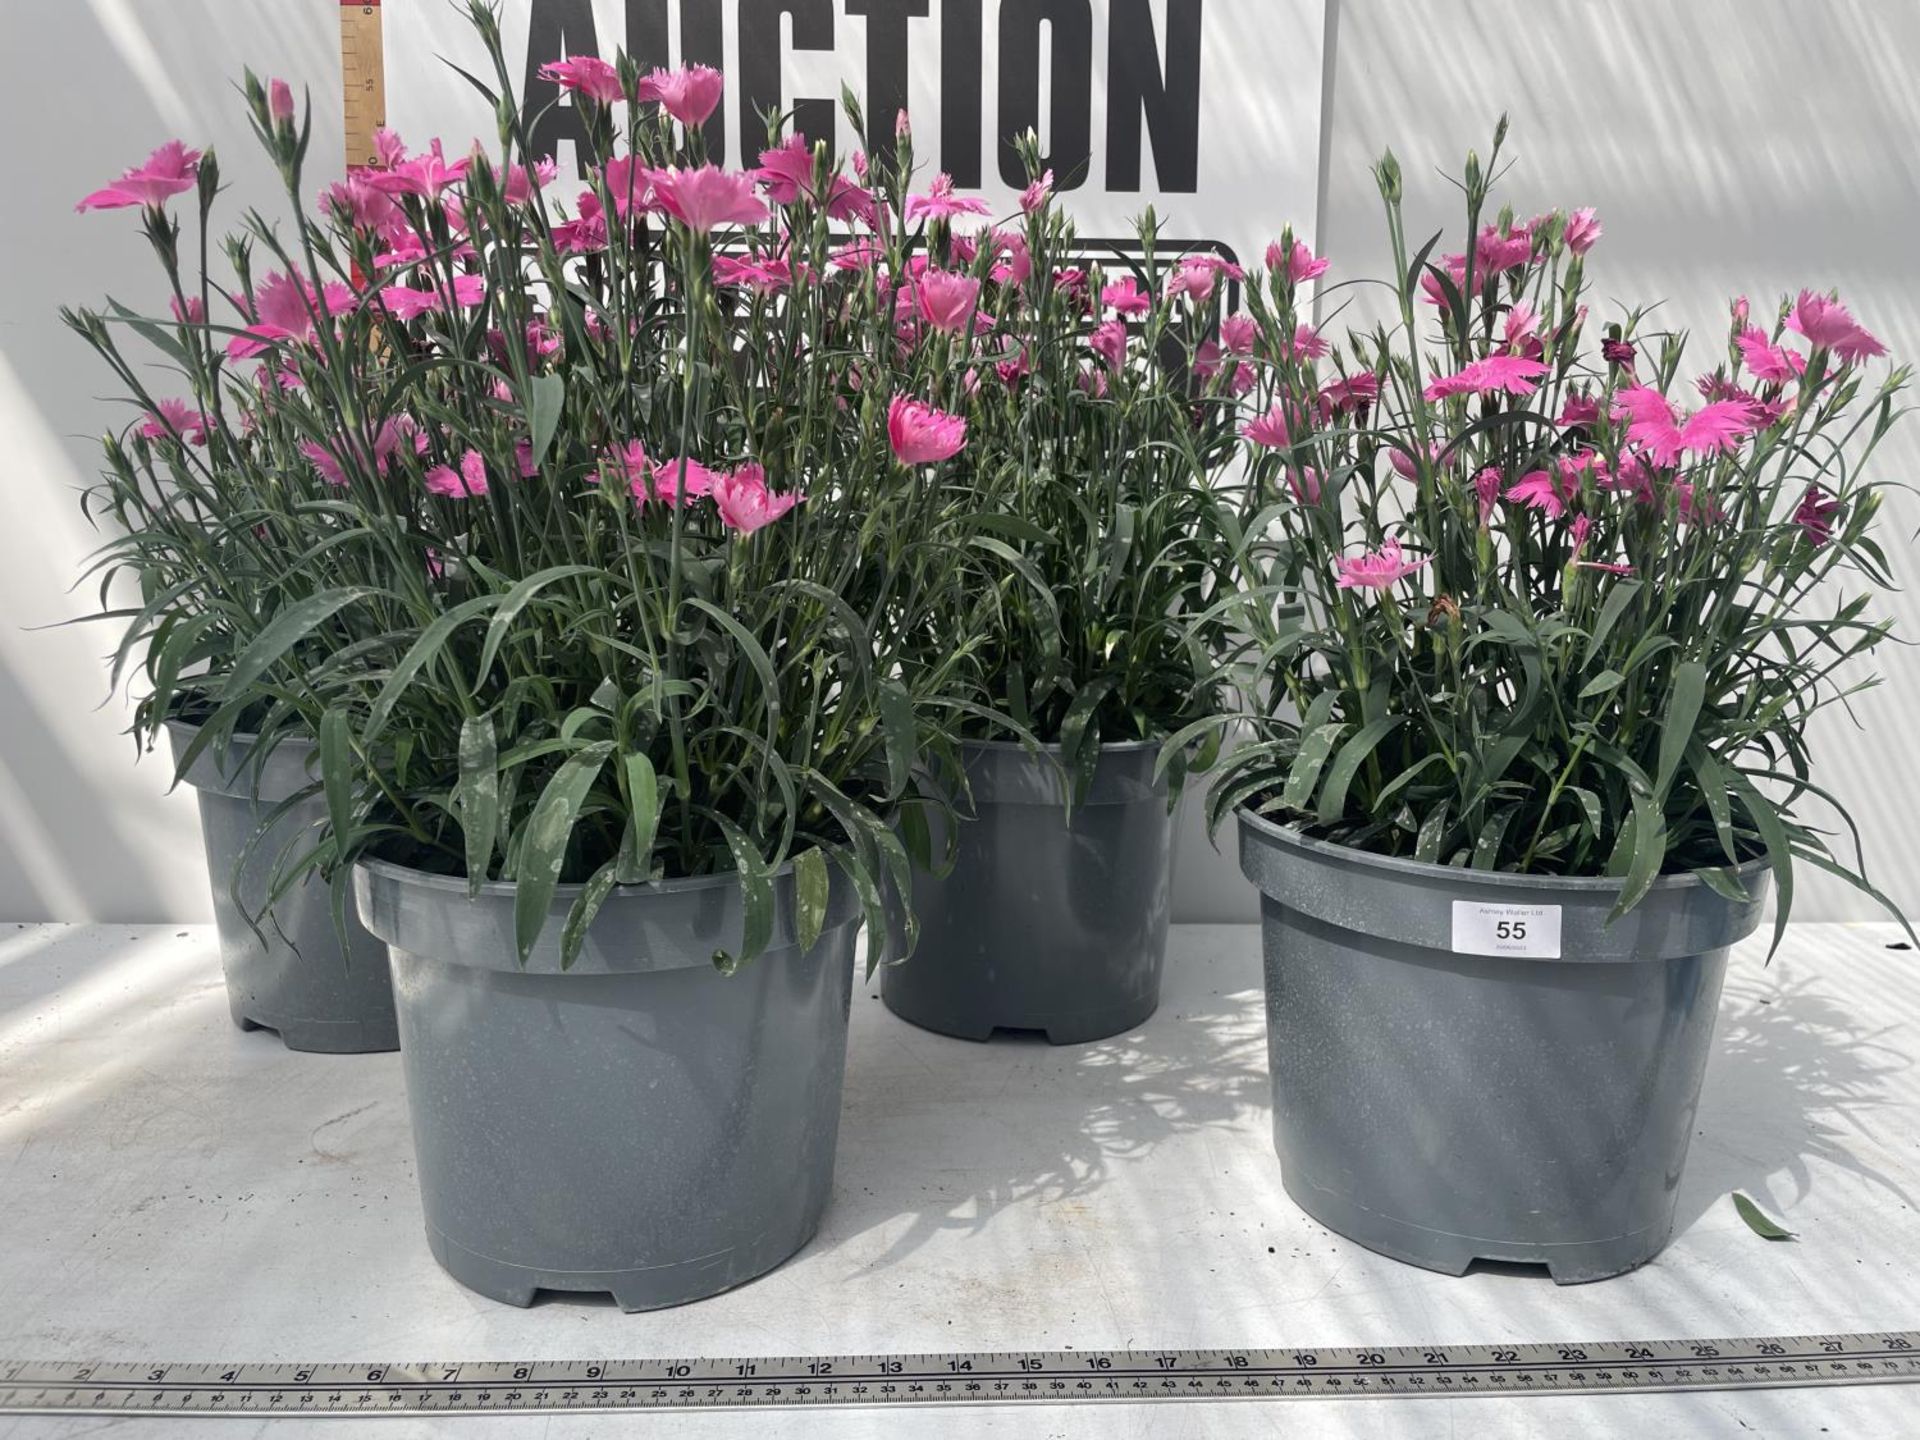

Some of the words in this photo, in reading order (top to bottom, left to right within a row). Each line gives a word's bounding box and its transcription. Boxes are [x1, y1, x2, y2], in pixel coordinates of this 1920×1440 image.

[365, 79, 374, 92] 55
[521, 0, 1201, 193] AUCTION
[1496, 921, 1526, 940] 55
[73, 1369, 91, 1380] 2
[148, 1369, 165, 1380] 3
[220, 1371, 235, 1381] 4
[294, 1371, 310, 1381] 5
[367, 1370, 384, 1381] 6
[442, 1369, 457, 1380] 7
[514, 1368, 529, 1379] 8
[587, 1367, 602, 1377] 9
[665, 1366, 690, 1376] 10
[736, 1365, 755, 1375] 11
[808, 1363, 832, 1374] 12
[878, 1362, 902, 1373] 13
[948, 1360, 972, 1371] 14
[1017, 1359, 1042, 1370] 15
[1086, 1358, 1111, 1369] 16
[1155, 1357, 1176, 1368] 17
[1224, 1356, 1248, 1366] 18
[1293, 1355, 1317, 1365] 19
[1357, 1354, 1385, 1365] 20
[1424, 1353, 1448, 1363] 21
[1491, 1351, 1520, 1362] 22
[1558, 1350, 1587, 1360] 23
[1625, 1349, 1653, 1359] 24
[1691, 1346, 1719, 1356] 25
[1756, 1344, 1785, 1354] 26
[1820, 1341, 1843, 1351] 27
[1882, 1339, 1912, 1349] 28
[154, 1394, 163, 1402] 8
[182, 1394, 191, 1402] 9
[211, 1394, 224, 1402] 10
[593, 1391, 608, 1399] 23
[652, 1390, 667, 1398] 25
[738, 1388, 753, 1396] 28
[766, 1388, 782, 1396] 29
[1077, 1381, 1092, 1389] 40
[1161, 1380, 1177, 1388] 43
[1271, 1378, 1285, 1386] 47
[1382, 1377, 1395, 1385] 51
[1410, 1376, 1425, 1384] 52
